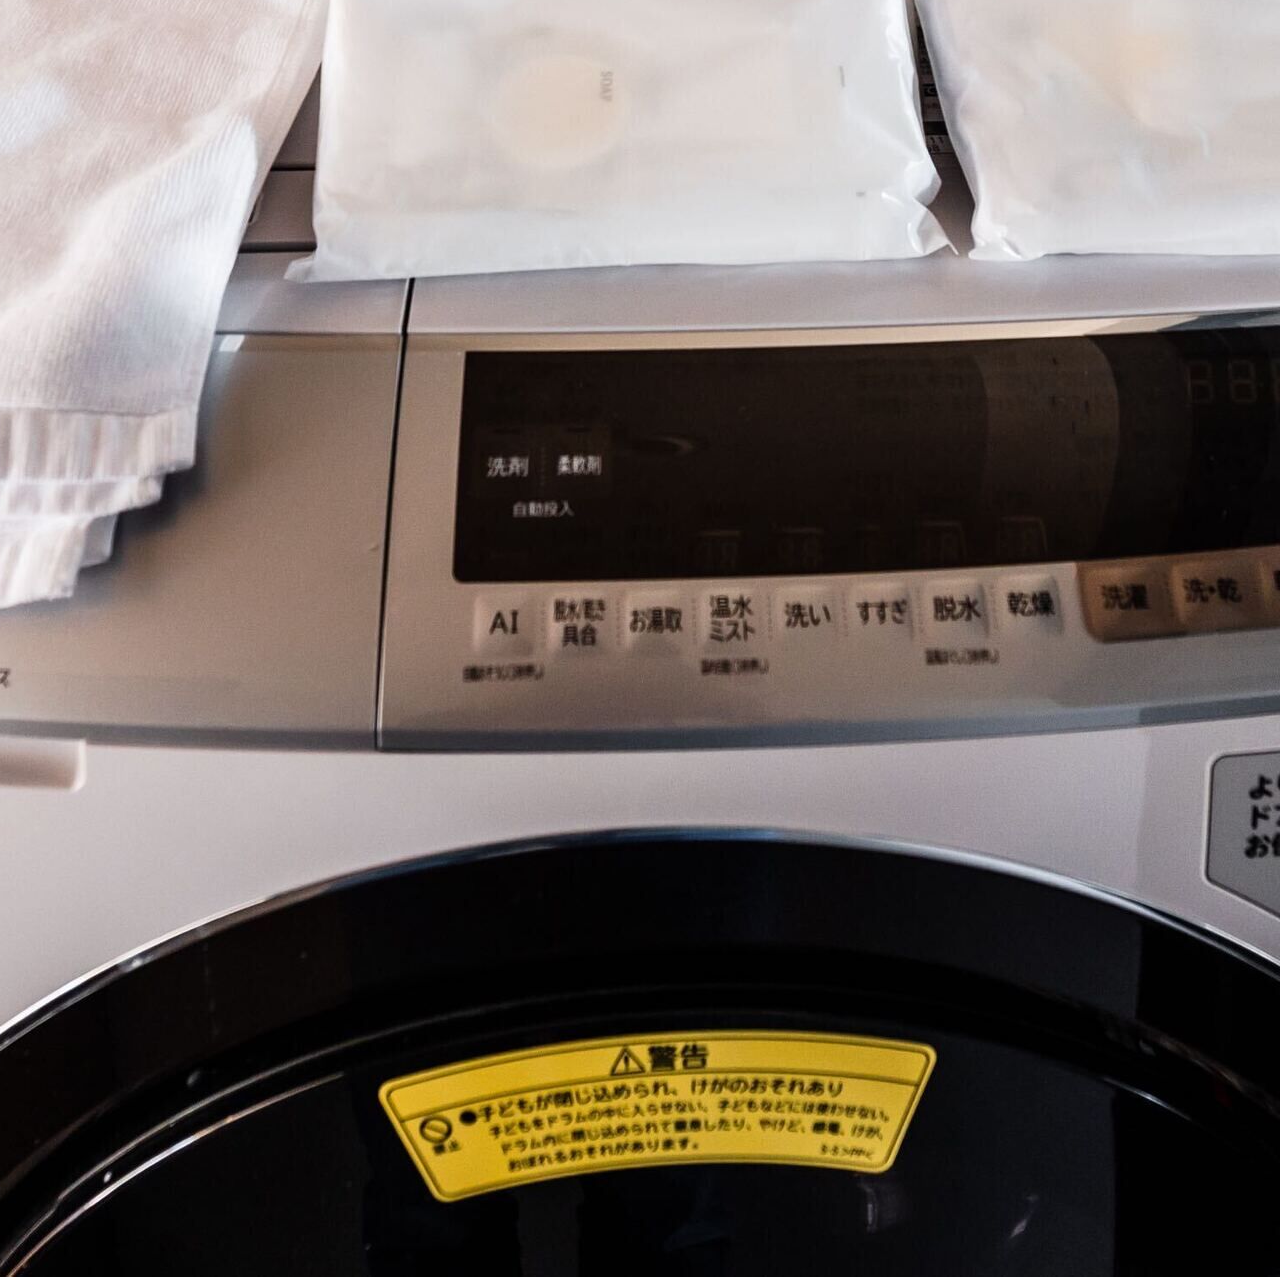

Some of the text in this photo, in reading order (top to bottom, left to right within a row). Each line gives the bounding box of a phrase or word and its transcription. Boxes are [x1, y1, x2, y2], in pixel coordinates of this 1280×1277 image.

[487, 456, 529, 477] 洗剤
[557, 454, 602, 475] 柔軟剤
[513, 500, 575, 518] 自動投入
[710, 595, 753, 619] 温水
[785, 602, 831, 628] 洗い
[856, 598, 908, 624] すすぎ
[933, 594, 982, 622] 脱水
[489, 609, 519, 635] AI
[630, 607, 683, 634] お湯取
[710, 619, 756, 642] ミスト
[648, 1044, 709, 1072] 警告
